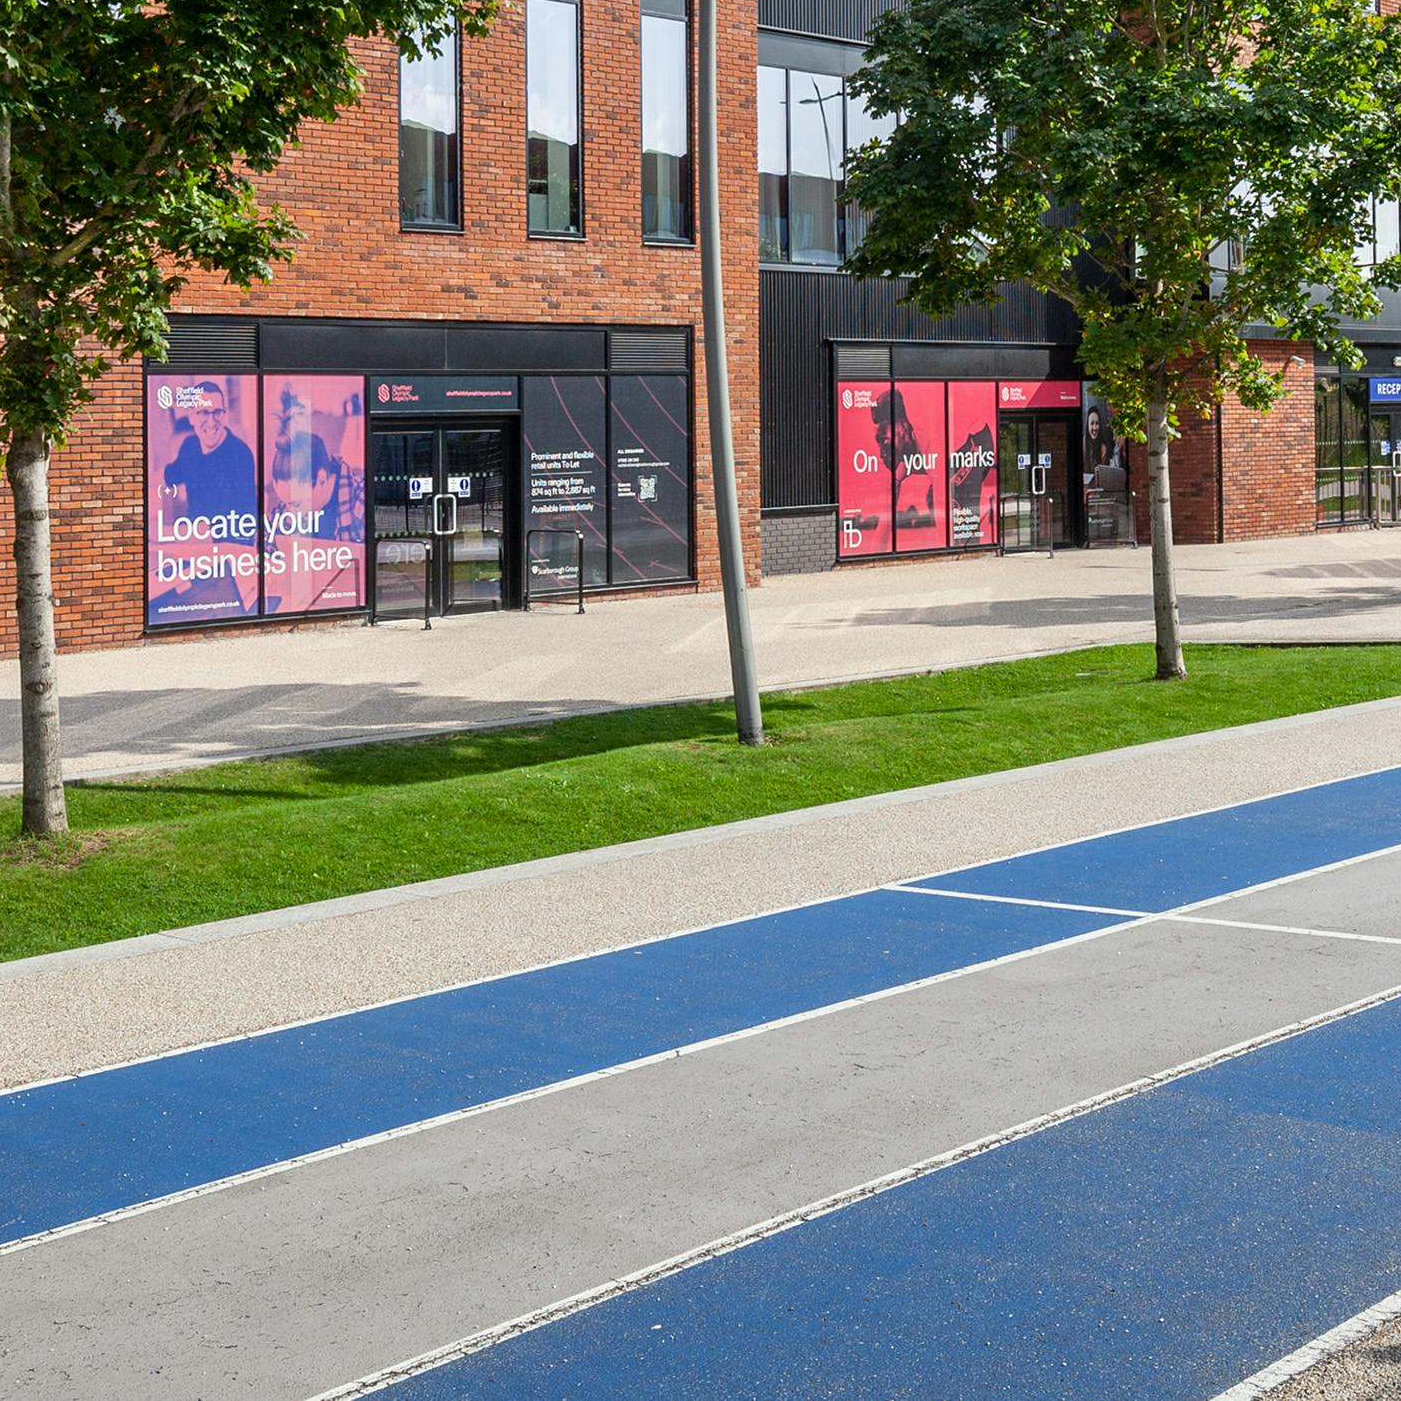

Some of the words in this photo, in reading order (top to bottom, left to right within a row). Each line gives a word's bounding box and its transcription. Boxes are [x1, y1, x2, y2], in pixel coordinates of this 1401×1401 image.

[176, 400, 198, 408] Legacy
[531, 452, 561, 461] Prominent
[562, 451, 573, 459] and
[574, 451, 594, 459] flexible
[854, 450, 878, 473] On
[903, 452, 938, 475] your
[950, 446, 994, 468] marks
[531, 461, 546, 470] retail
[547, 460, 561, 469] units
[561, 460, 569, 468] To
[570, 460, 580, 468] Let
[531, 478, 547, 487] Units
[548, 478, 569, 488] ranging
[570, 477, 584, 485] from
[544, 489, 551, 497] sq
[552, 487, 558, 495] ft
[582, 487, 590, 495] sq
[590, 485, 596, 493] ft
[531, 504, 558, 514] Available
[559, 502, 594, 513] immediately
[157, 509, 256, 542] Locate
[263, 509, 324, 543] your
[158, 547, 286, 582] business
[293, 542, 352, 572] here
